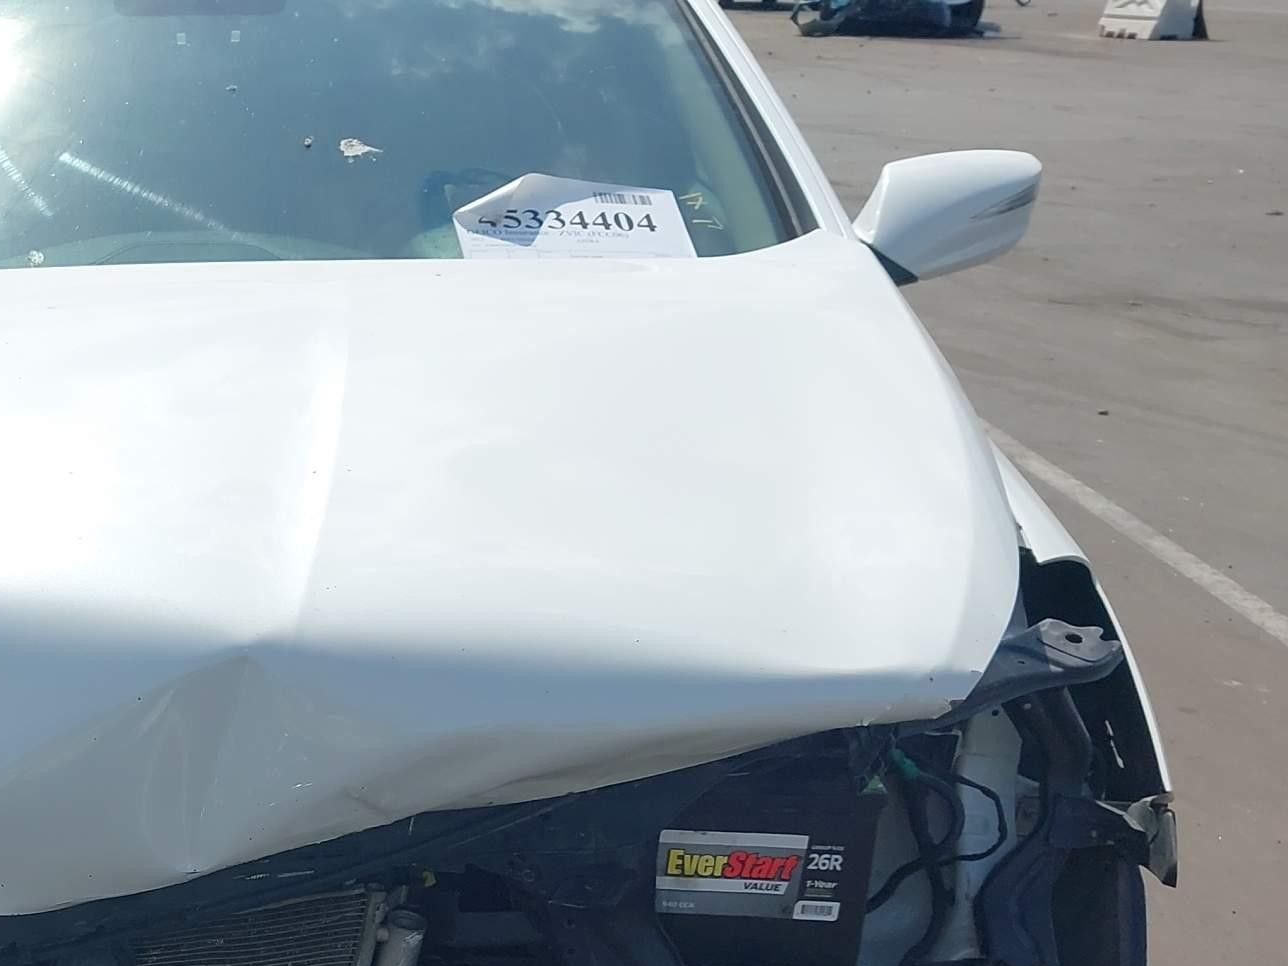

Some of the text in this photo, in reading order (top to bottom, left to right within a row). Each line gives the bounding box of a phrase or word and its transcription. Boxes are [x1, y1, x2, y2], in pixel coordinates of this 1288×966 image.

[666, 847, 800, 881] EverStart
[807, 853, 843, 871] 26R
[743, 881, 782, 892] VALUE
